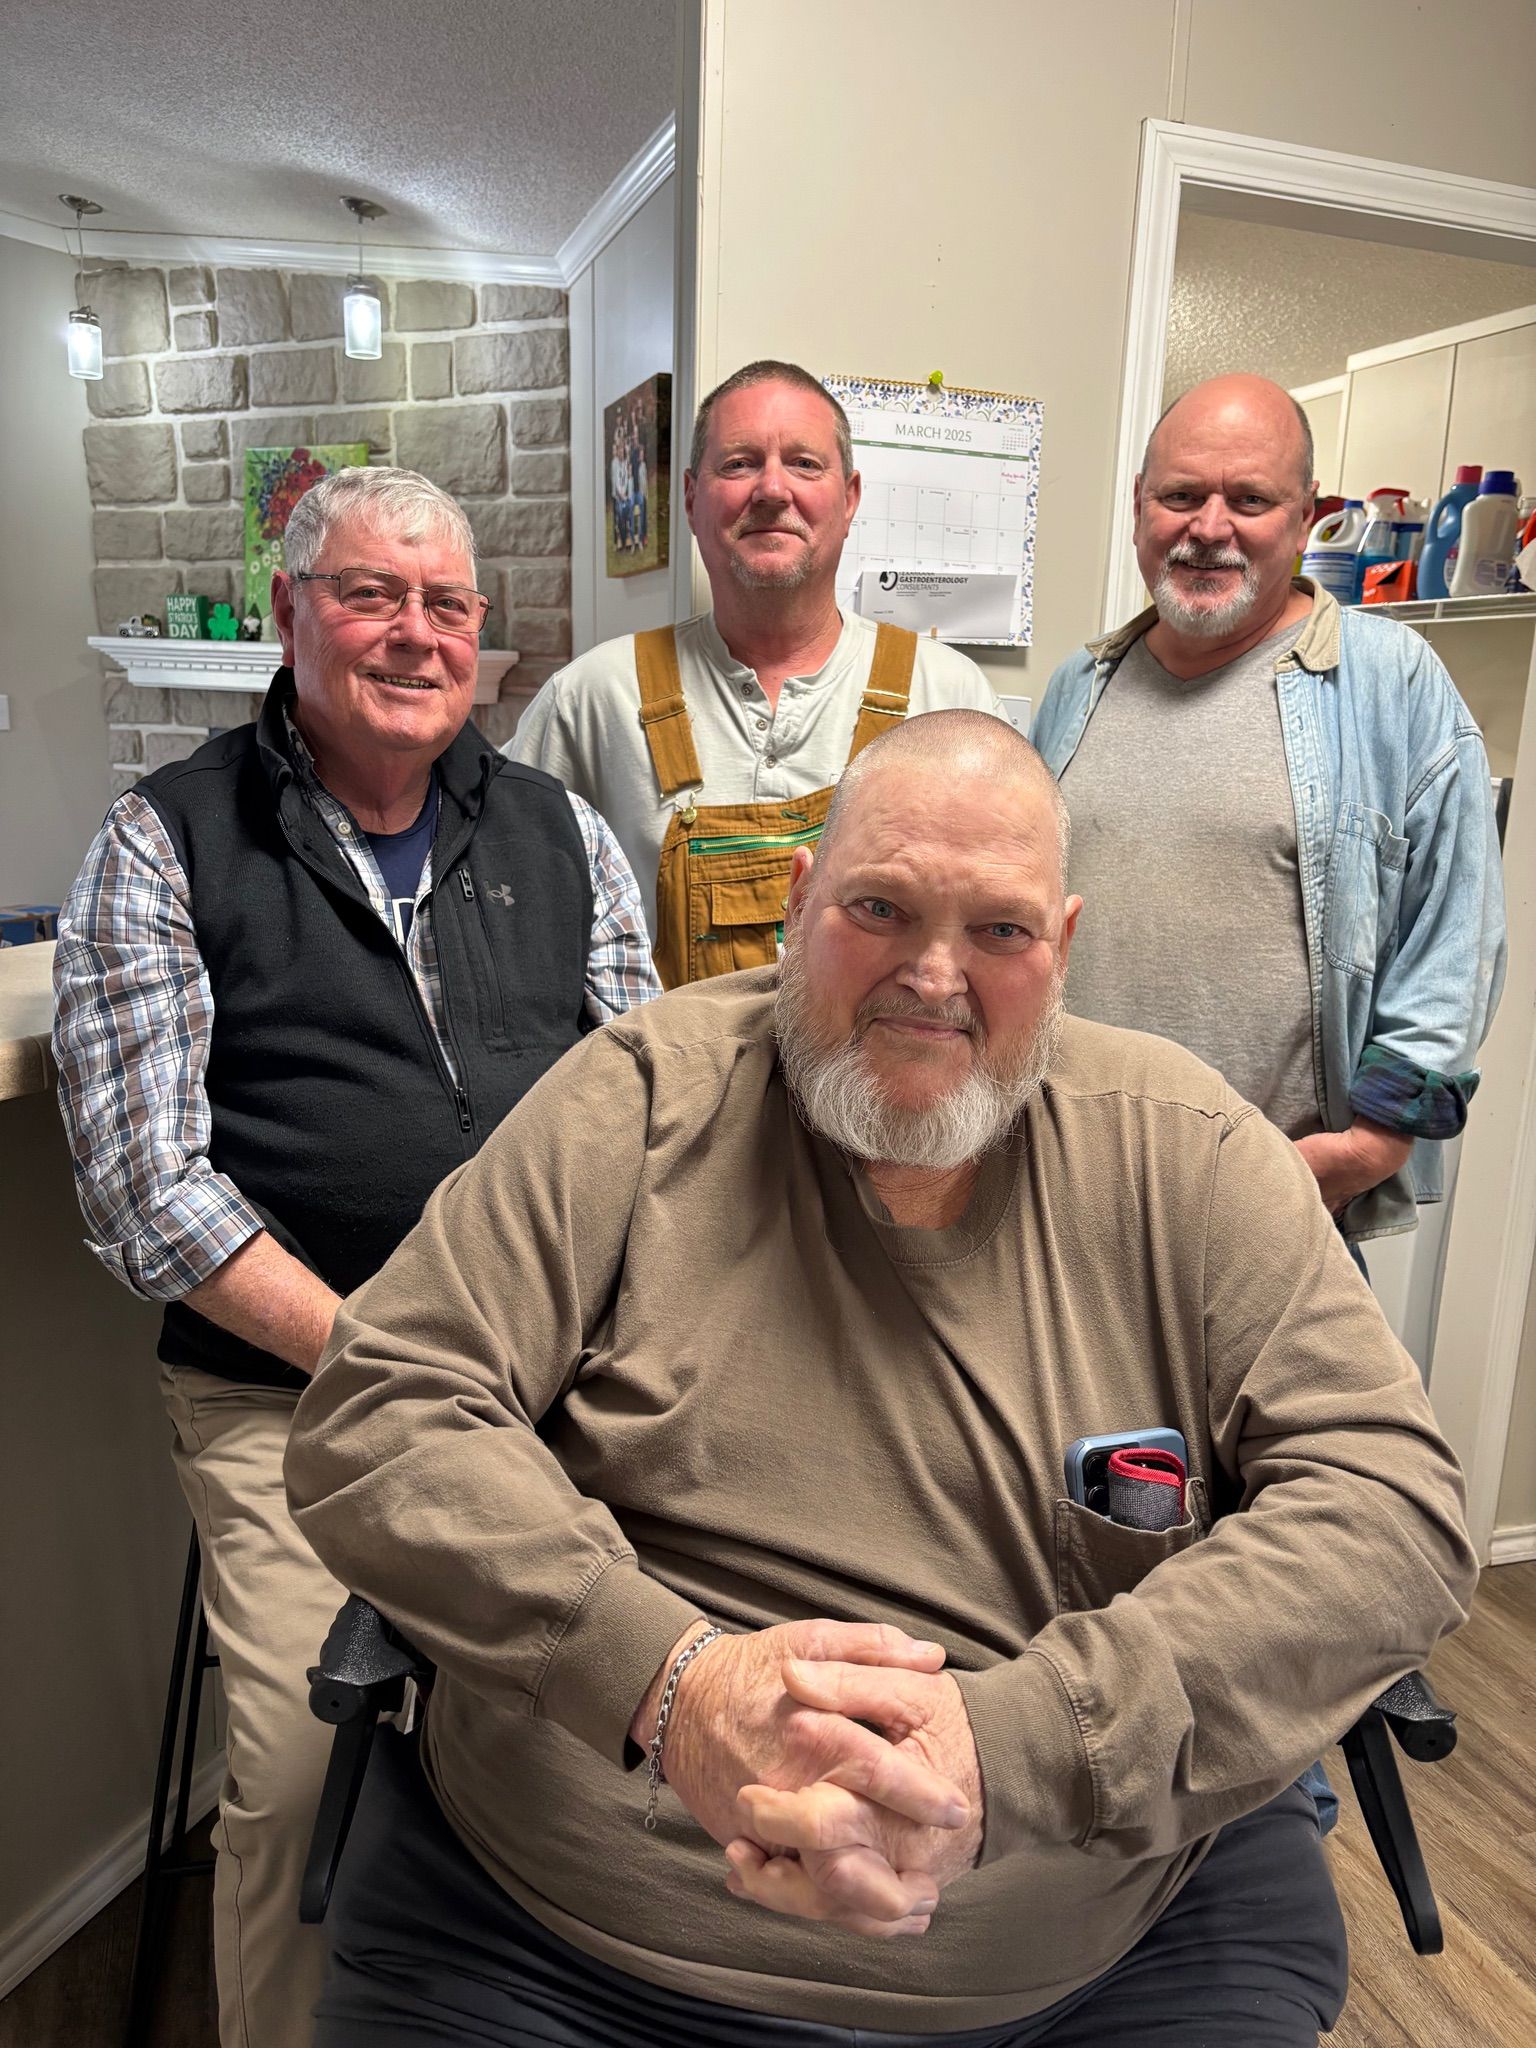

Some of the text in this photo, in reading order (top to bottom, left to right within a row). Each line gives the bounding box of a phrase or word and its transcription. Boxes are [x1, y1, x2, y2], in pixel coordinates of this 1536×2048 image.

[895, 423, 972, 443] MARCH 2025
[896, 583, 940, 591] CONSULTANTS
[899, 576, 969, 584] GASTROENTEROLOGY
[167, 597, 197, 612] HAPPY
[169, 623, 199, 638] DAY
